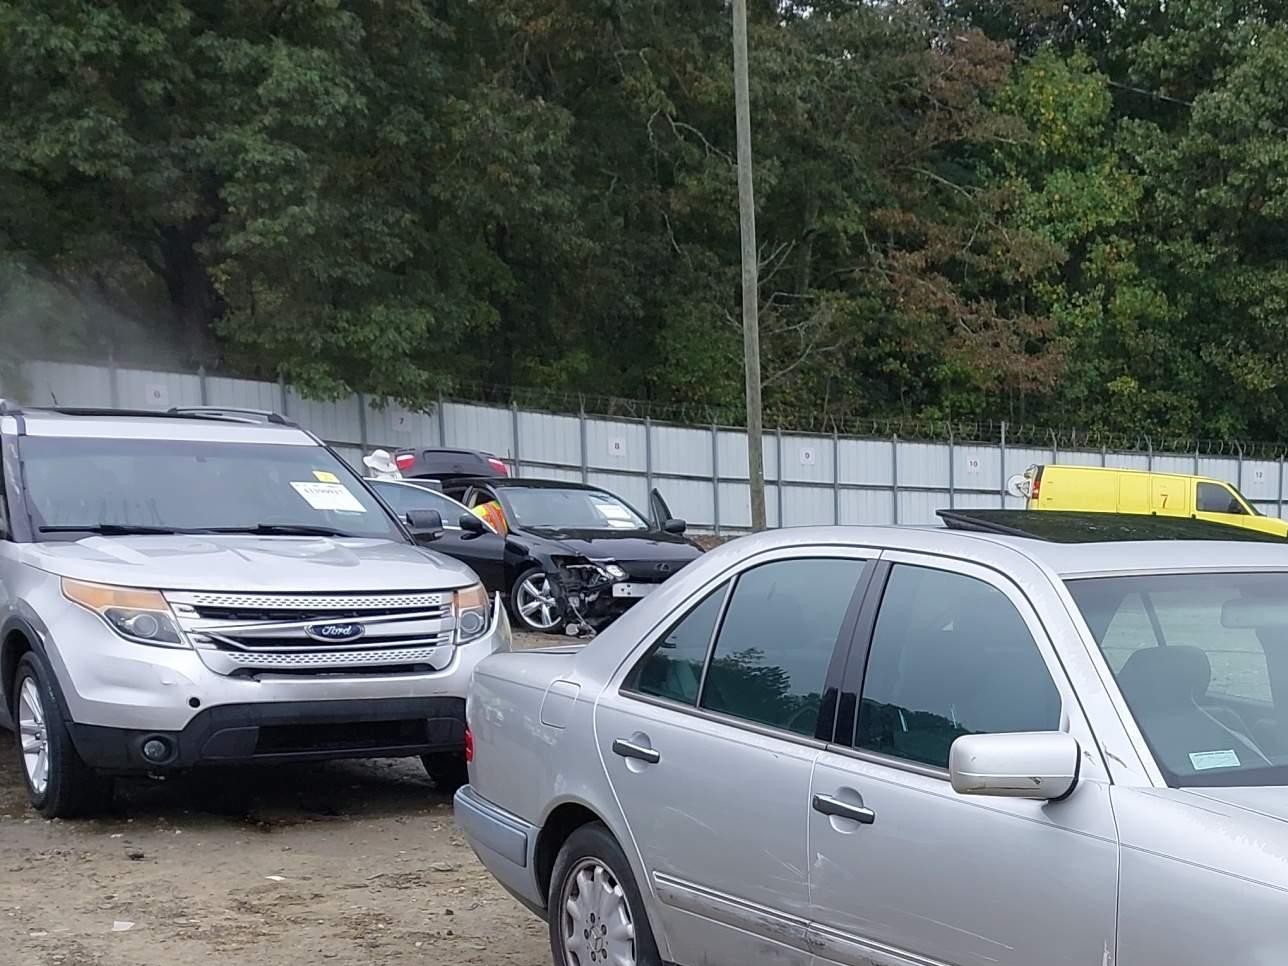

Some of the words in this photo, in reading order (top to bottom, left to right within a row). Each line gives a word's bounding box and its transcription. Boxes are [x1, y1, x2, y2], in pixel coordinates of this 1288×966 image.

[969, 460, 978, 468] 10
[1160, 494, 1168, 509] 7
[321, 625, 352, 635] Ford
